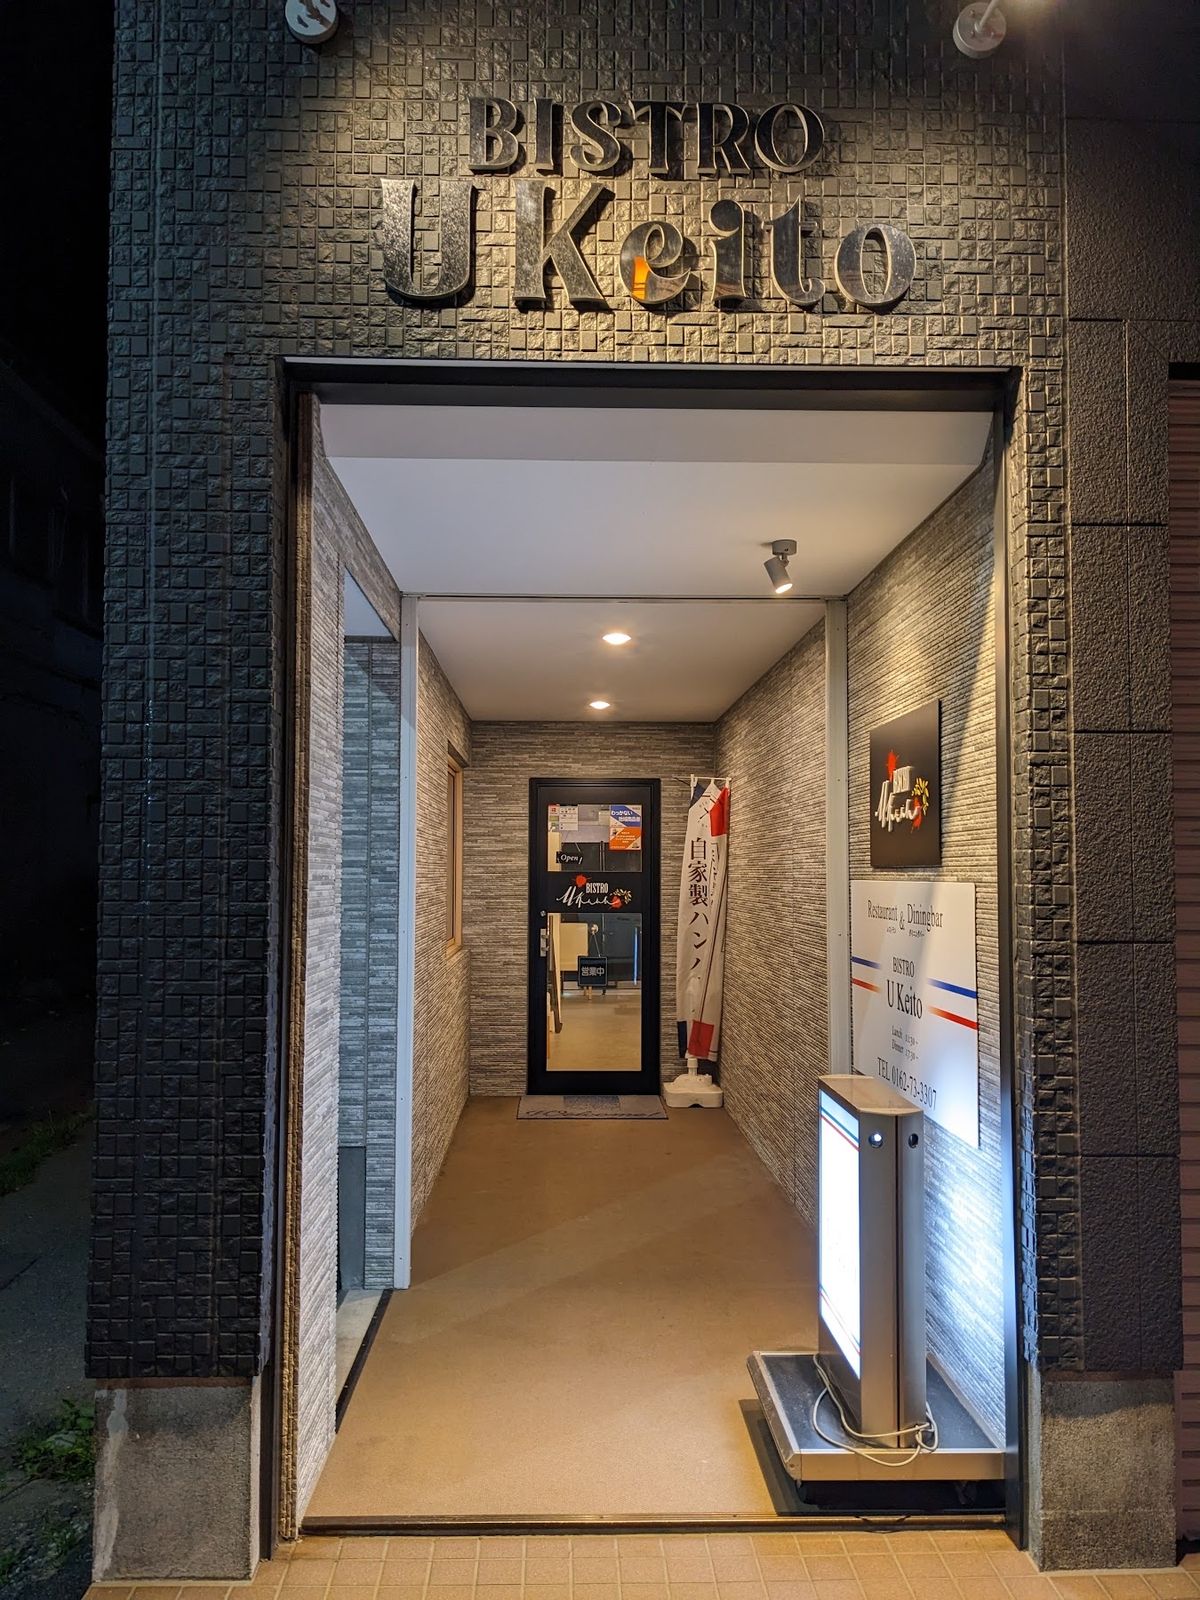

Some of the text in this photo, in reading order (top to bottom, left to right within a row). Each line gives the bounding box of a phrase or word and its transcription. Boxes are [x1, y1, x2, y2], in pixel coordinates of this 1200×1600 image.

[468, 96, 826, 175] BISTRO
[560, 854, 579, 862] Open
[585, 882, 609, 894] BISTRO
[867, 899, 898, 922] Restaurant
[906, 903, 943, 932] Diningbar
[581, 966, 605, 977] 営業中
[892, 956, 915, 978] BISTRO
[877, 1056, 937, 1110] TEL 0162-73-3307
